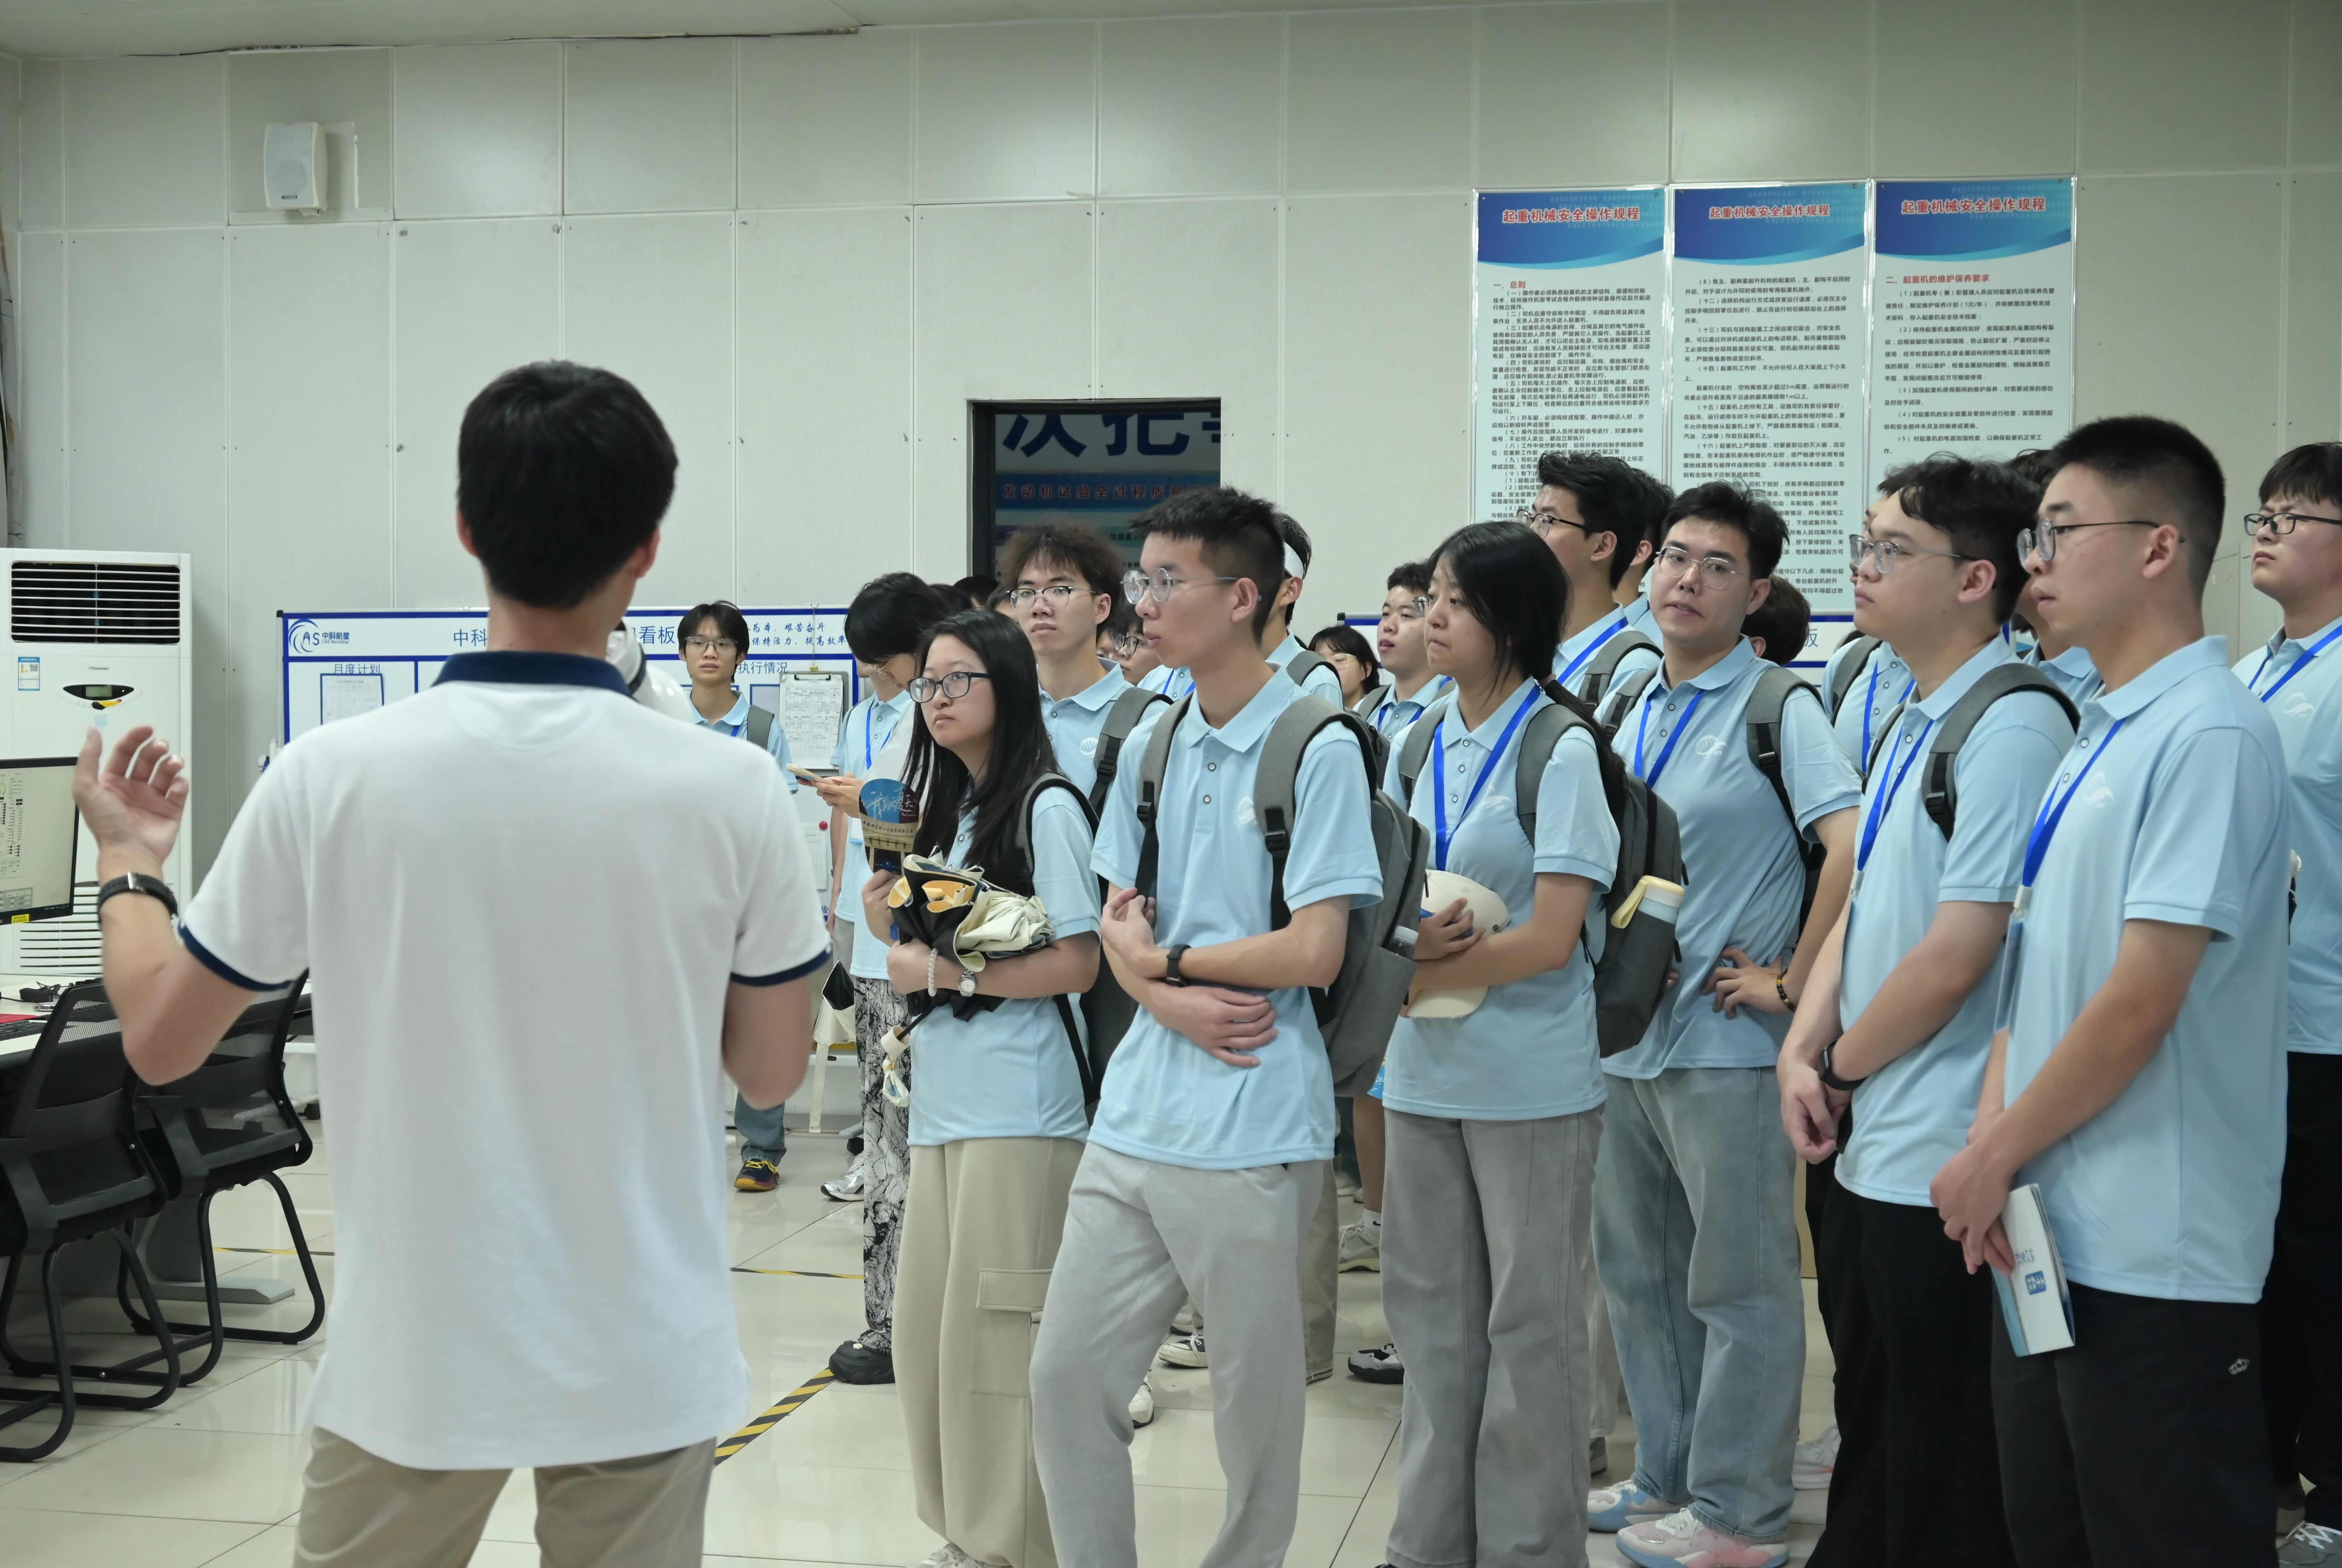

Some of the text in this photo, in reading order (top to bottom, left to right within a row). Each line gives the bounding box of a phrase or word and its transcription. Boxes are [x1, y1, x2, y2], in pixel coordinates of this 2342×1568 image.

[1709, 204, 1830, 219] 起重机械安全操作规程
[1901, 197, 2046, 215] 起重机械安全操作规程
[1502, 207, 1640, 223] 起重机械安全操作规程
[1493, 281, 1525, 289] 一、总则
[639, 626, 675, 644] 看板
[334, 664, 380, 674] 月度计划
